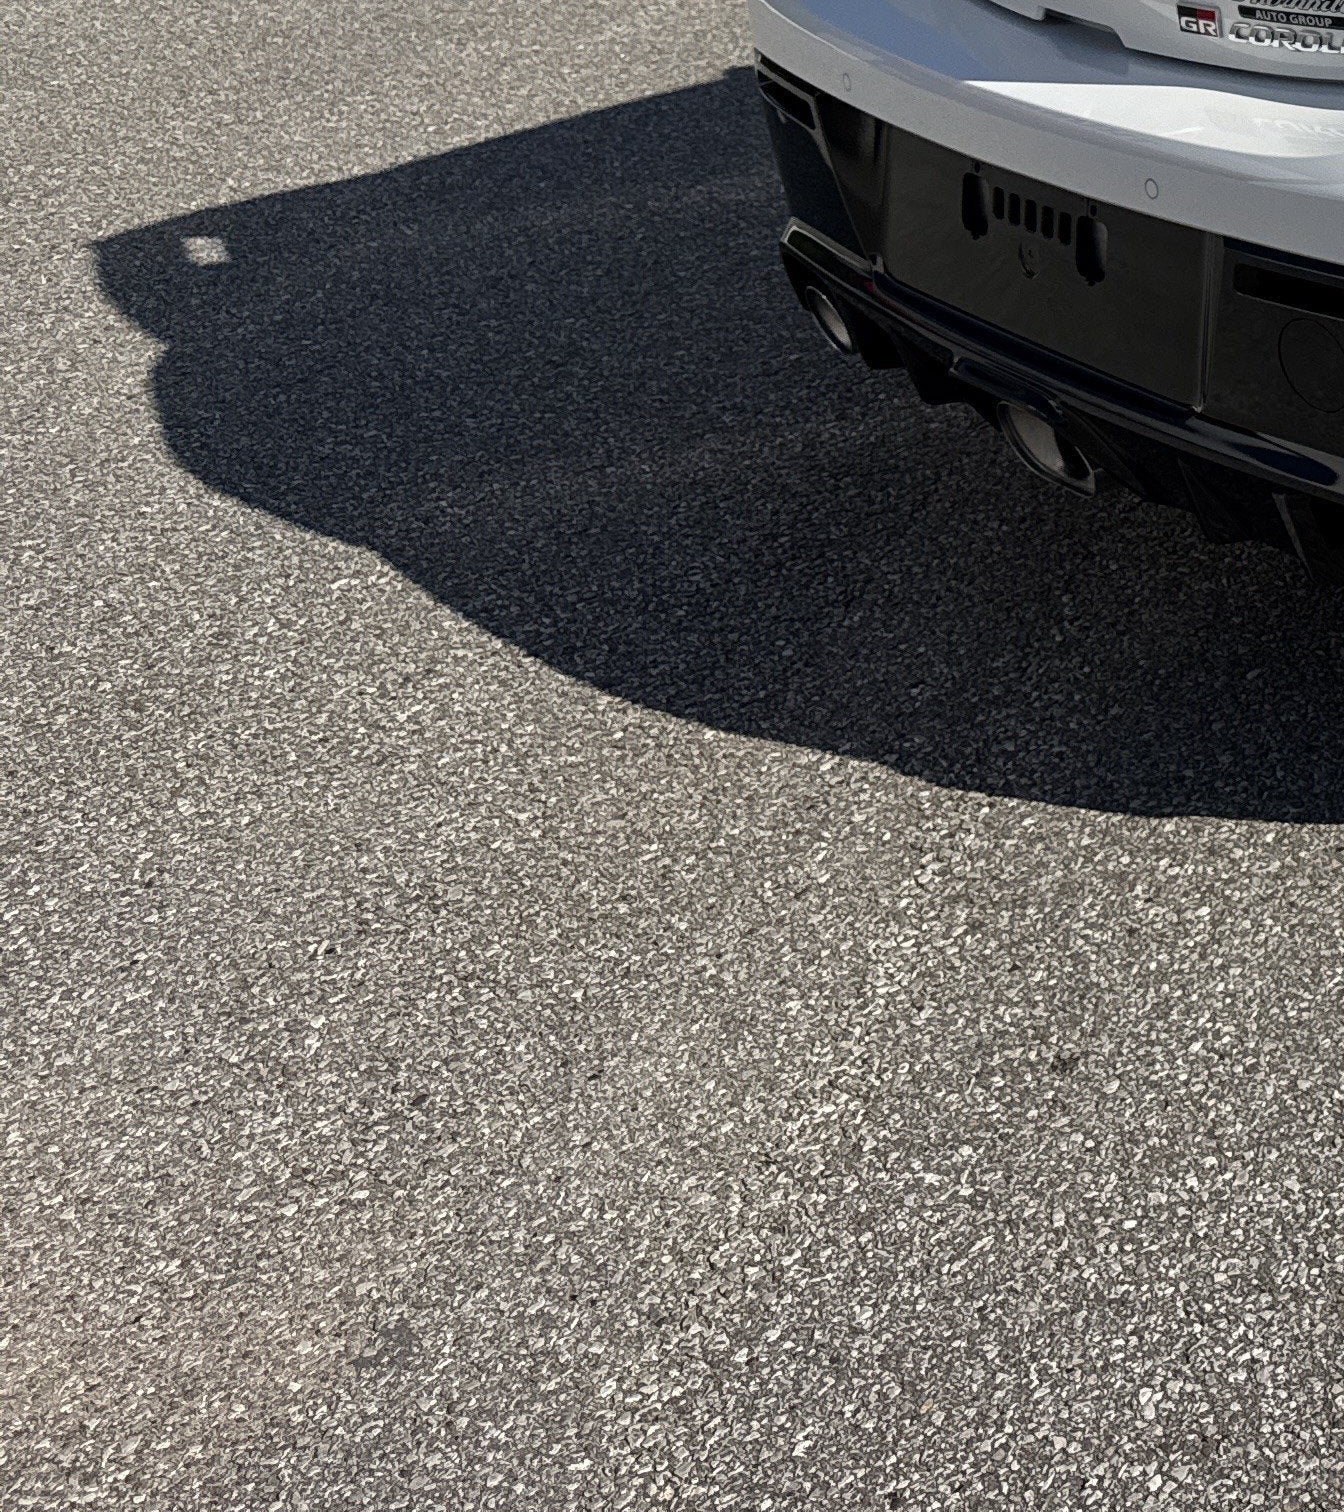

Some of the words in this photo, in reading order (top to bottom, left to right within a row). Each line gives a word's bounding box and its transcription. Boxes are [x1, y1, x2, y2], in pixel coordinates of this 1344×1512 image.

[1181, 16, 1219, 37] GR
[1254, 9, 1287, 24] AUTO
[1289, 13, 1333, 28] GROUP
